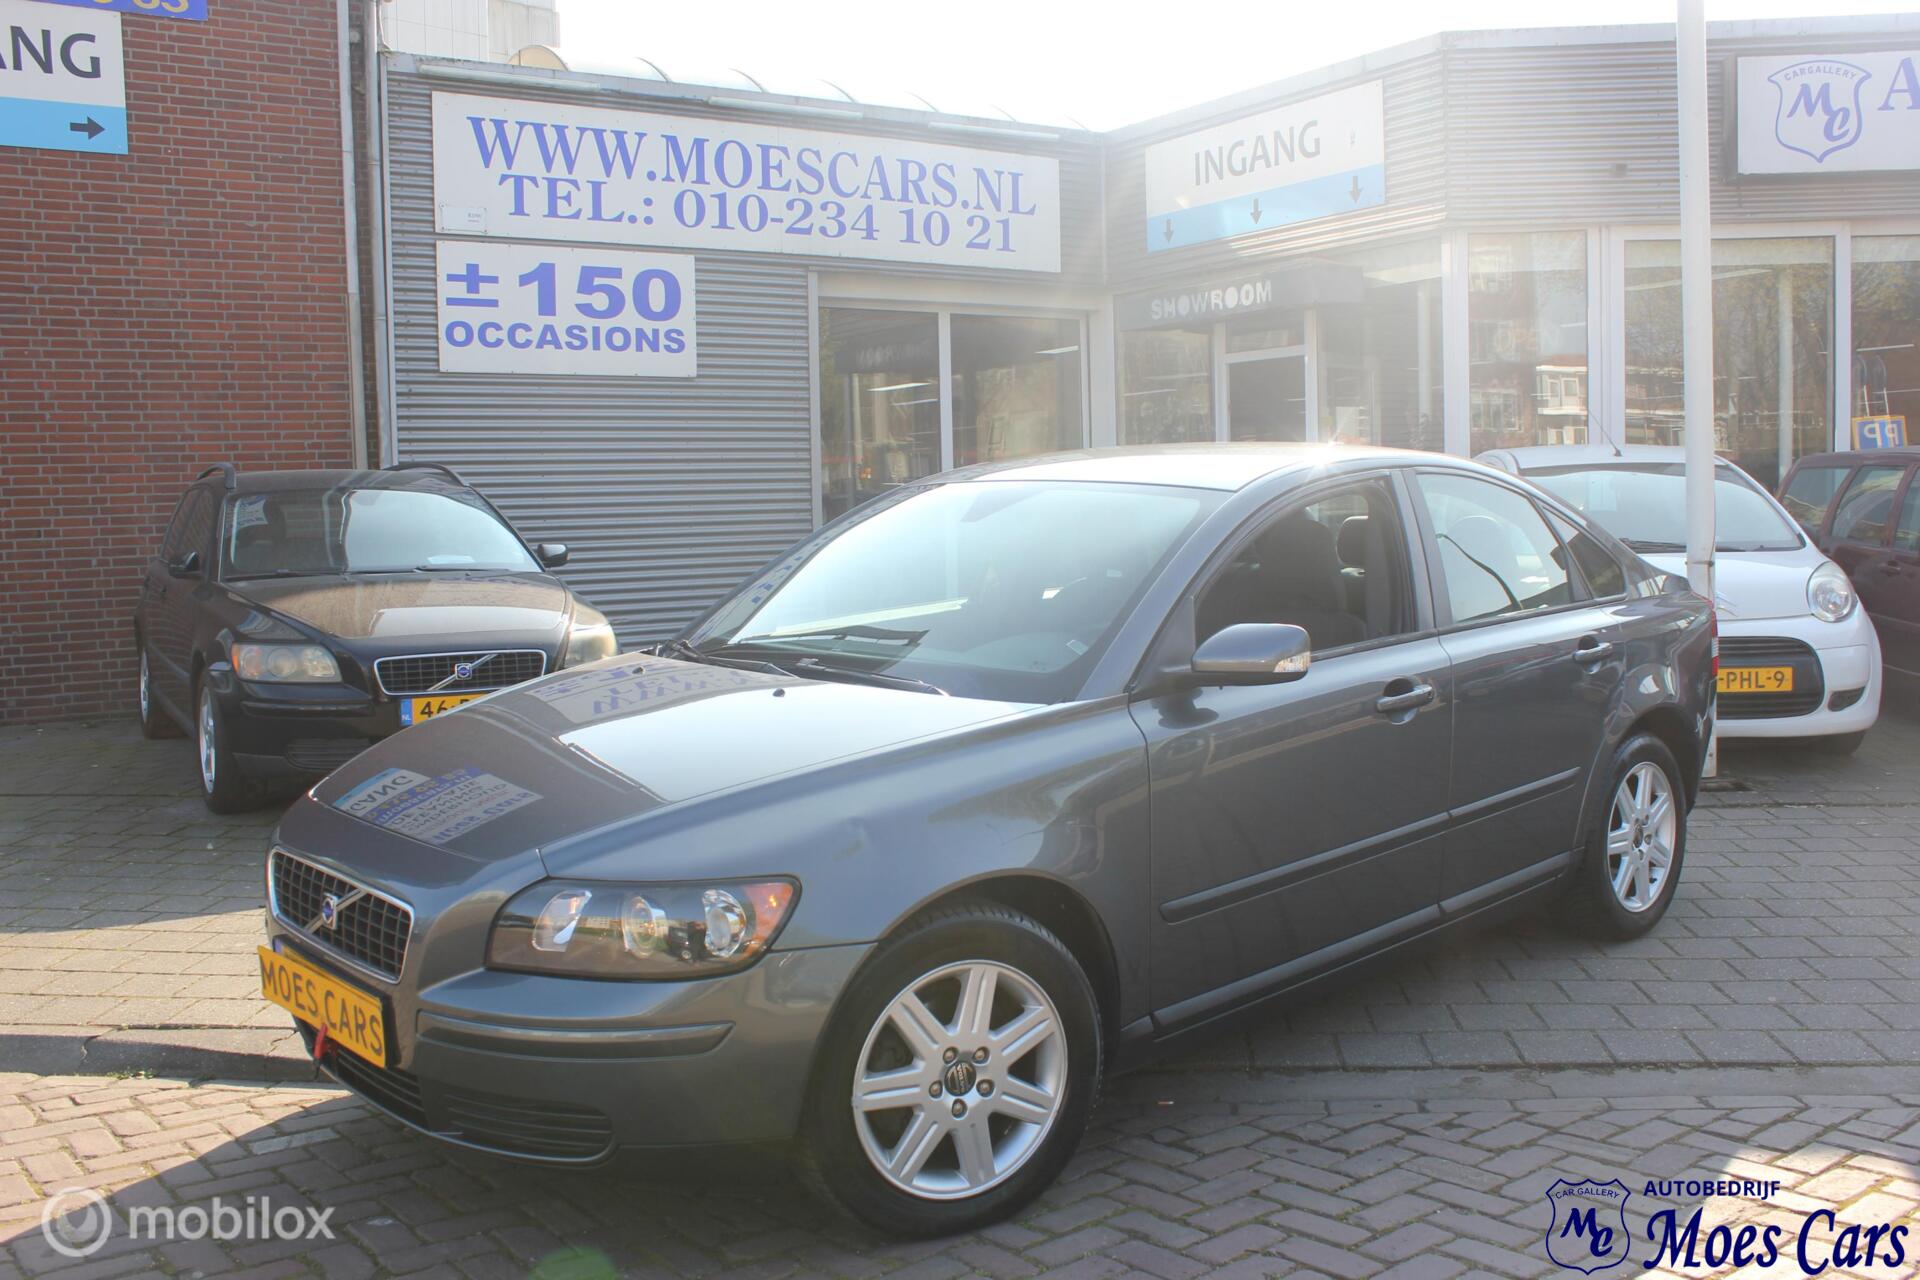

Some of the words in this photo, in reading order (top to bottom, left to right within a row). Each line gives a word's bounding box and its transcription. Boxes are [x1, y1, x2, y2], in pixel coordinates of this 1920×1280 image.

[0, 25, 101, 79] NG
[1784, 65, 1857, 81] CARGALLERY
[466, 116, 1037, 217] WWW.MOESCARS.NL
[1193, 119, 1322, 188] INGANG
[498, 173, 655, 226] TEL.:
[673, 189, 880, 241] 010-234
[899, 208, 951, 247] 10
[965, 215, 1017, 253] 21
[1150, 279, 1272, 320] SHOWROOM
[444, 320, 686, 354] OCCASIONS
[260, 956, 319, 1019] MOES
[323, 989, 383, 1058] CARS
